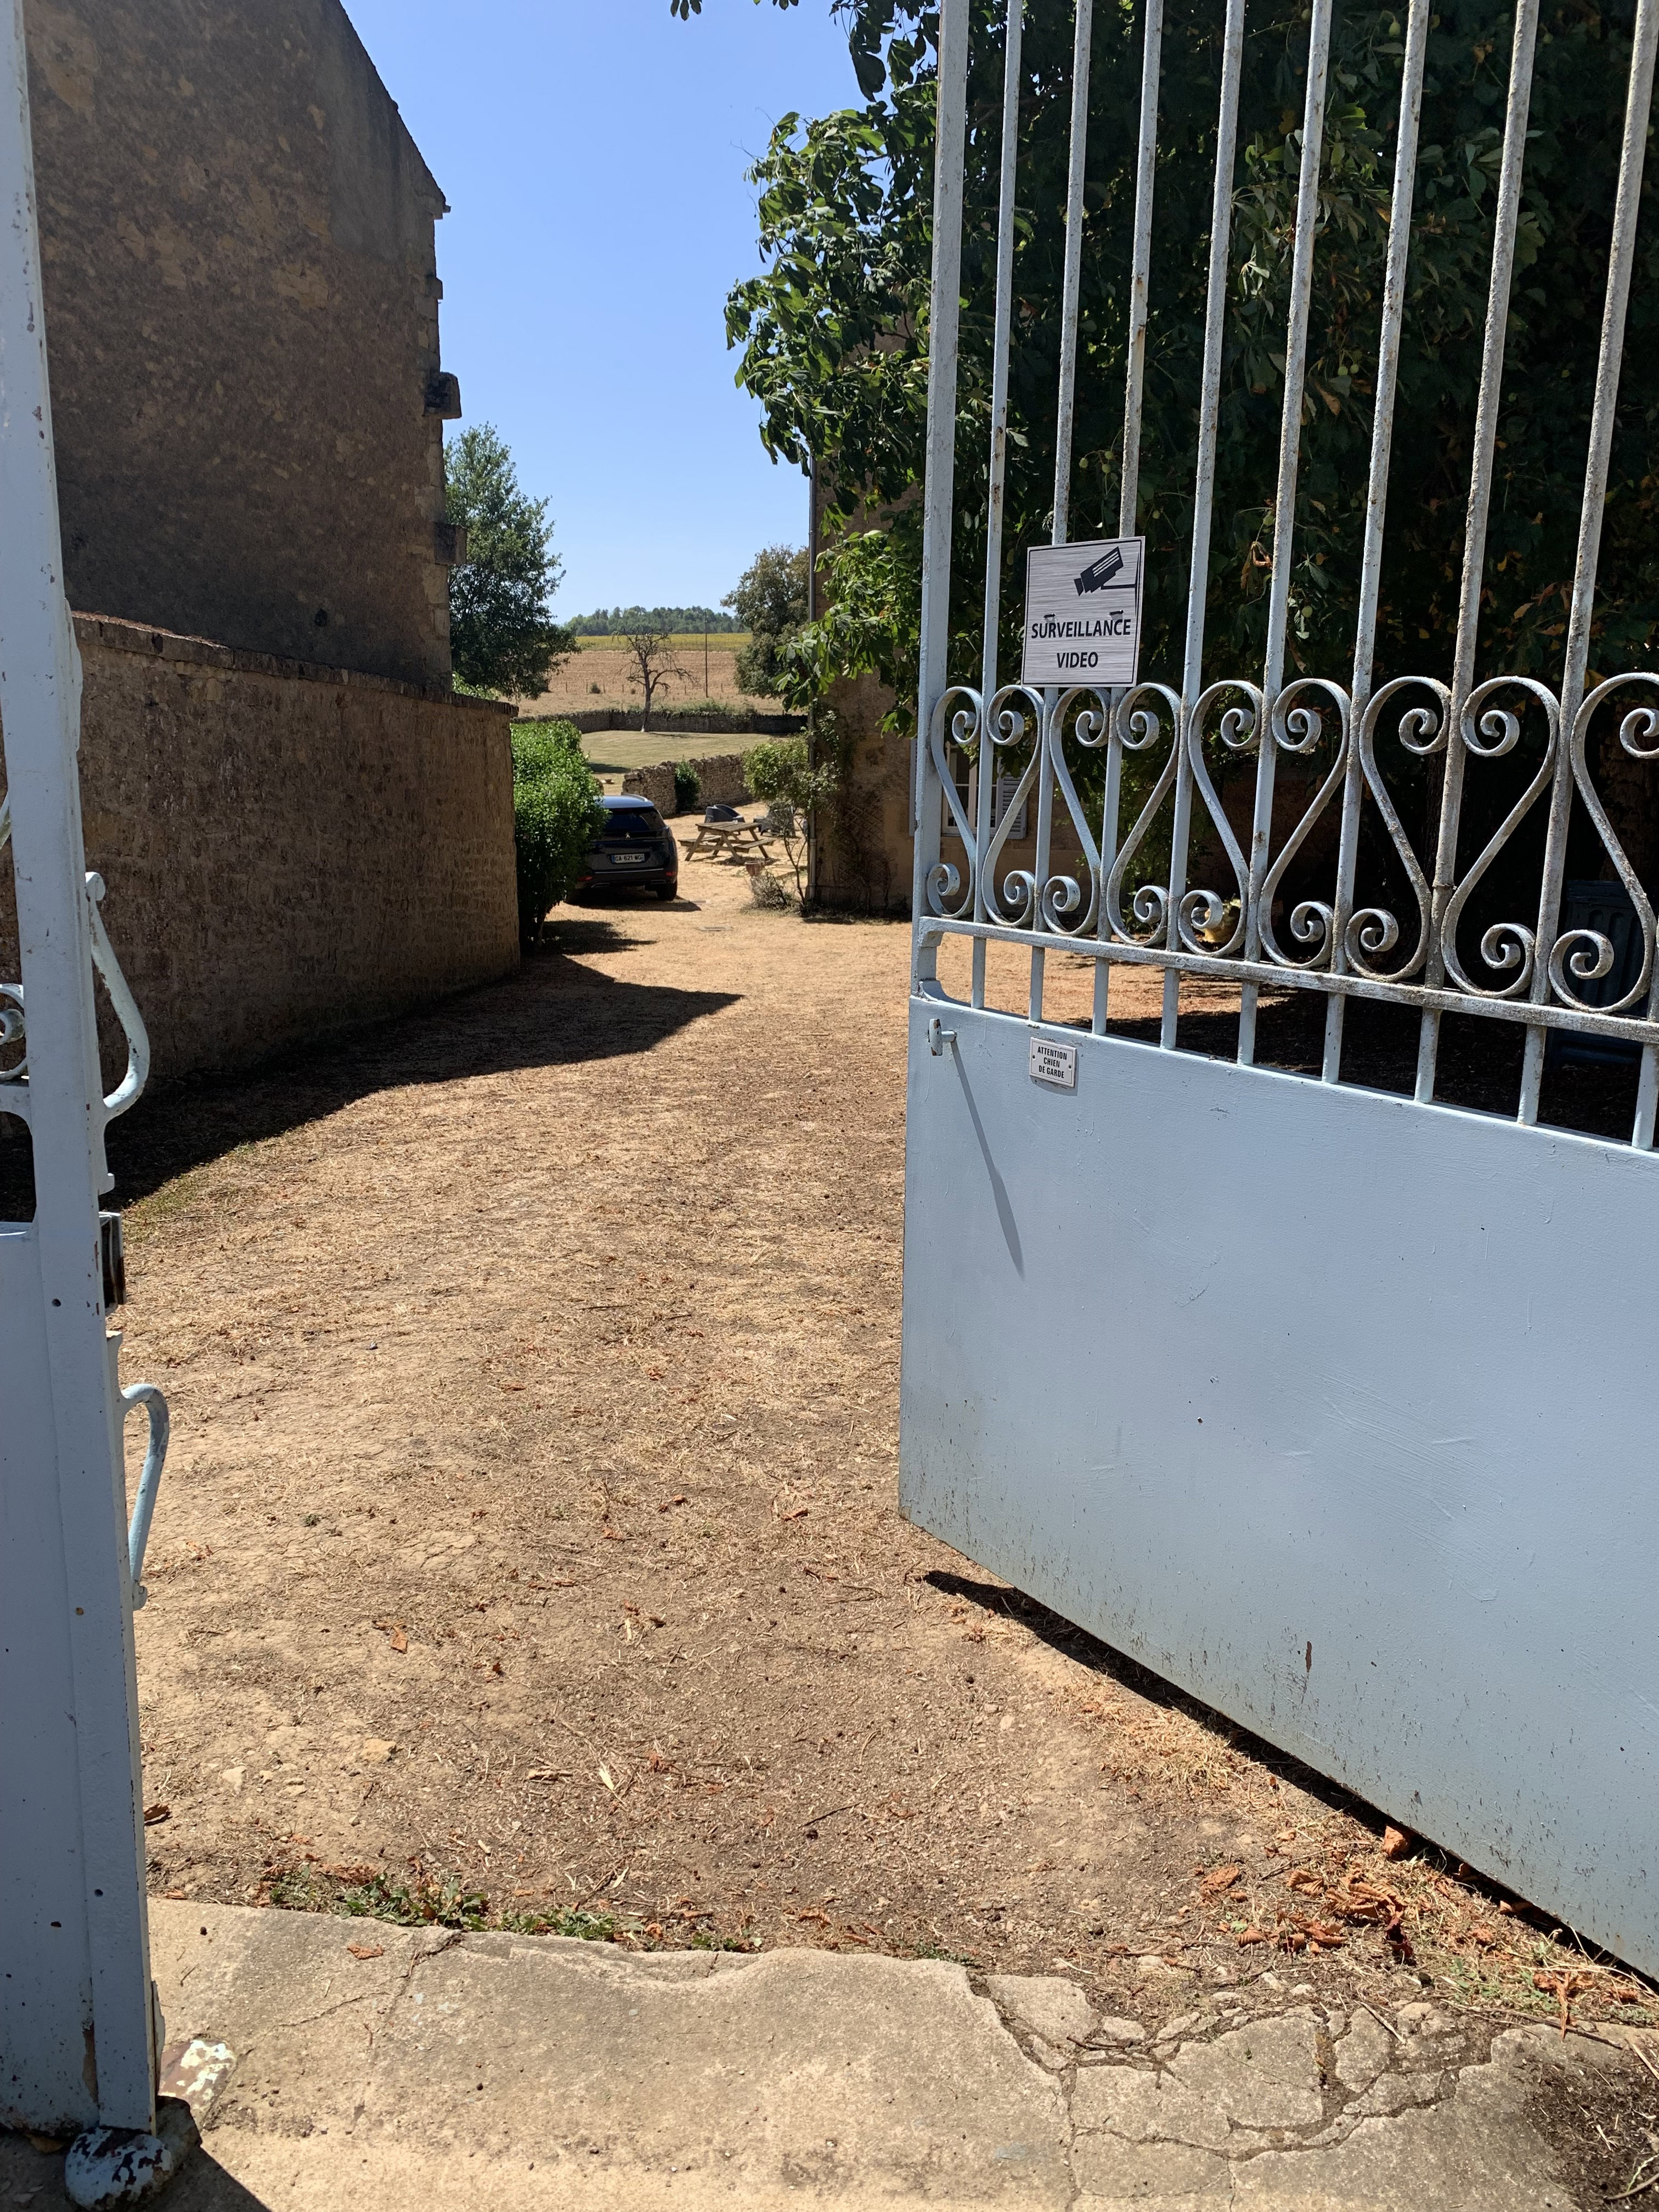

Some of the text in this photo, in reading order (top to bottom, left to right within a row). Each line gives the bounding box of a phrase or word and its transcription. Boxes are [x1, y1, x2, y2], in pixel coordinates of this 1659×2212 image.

[1031, 619, 1131, 639] SURVEILLANCE
[1057, 651, 1098, 668] VIDEO
[1037, 1046, 1067, 1060] ATTENTION
[1043, 1057, 1060, 1068] CHIEN
[1047, 1068, 1064, 1079] GARDE
